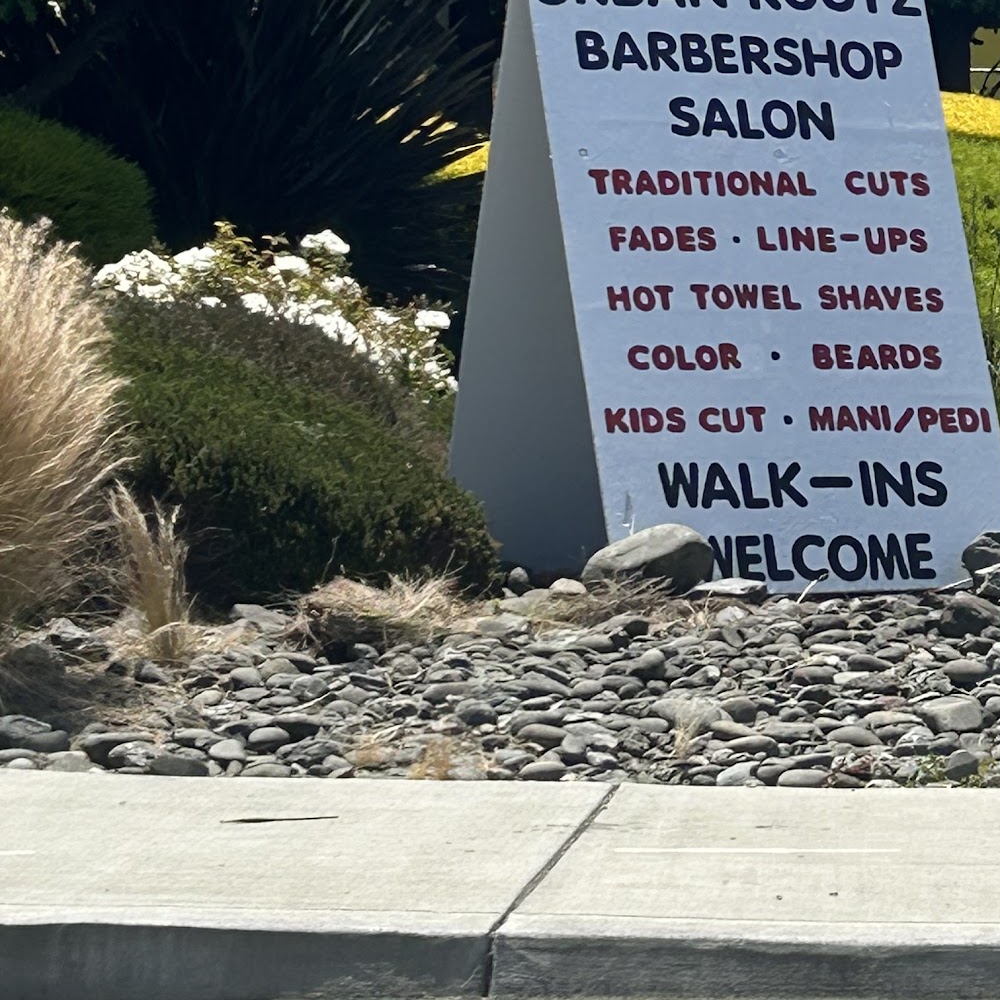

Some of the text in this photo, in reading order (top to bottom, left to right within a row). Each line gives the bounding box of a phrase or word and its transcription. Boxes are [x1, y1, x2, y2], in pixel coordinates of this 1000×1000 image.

[574, 30, 903, 81] BARBERSHOP
[668, 96, 836, 142] SALON
[587, 168, 931, 197] TRADITIONAL CUTS
[608, 225, 928, 255] FADES LINE-UPS
[606, 283, 944, 313] HOT TOWEL SHAVES
[627, 342, 943, 371] COLOR BEARDS
[603, 404, 992, 434] KIDS CUT MANI/PEDI
[657, 460, 948, 510] WALK-INS
